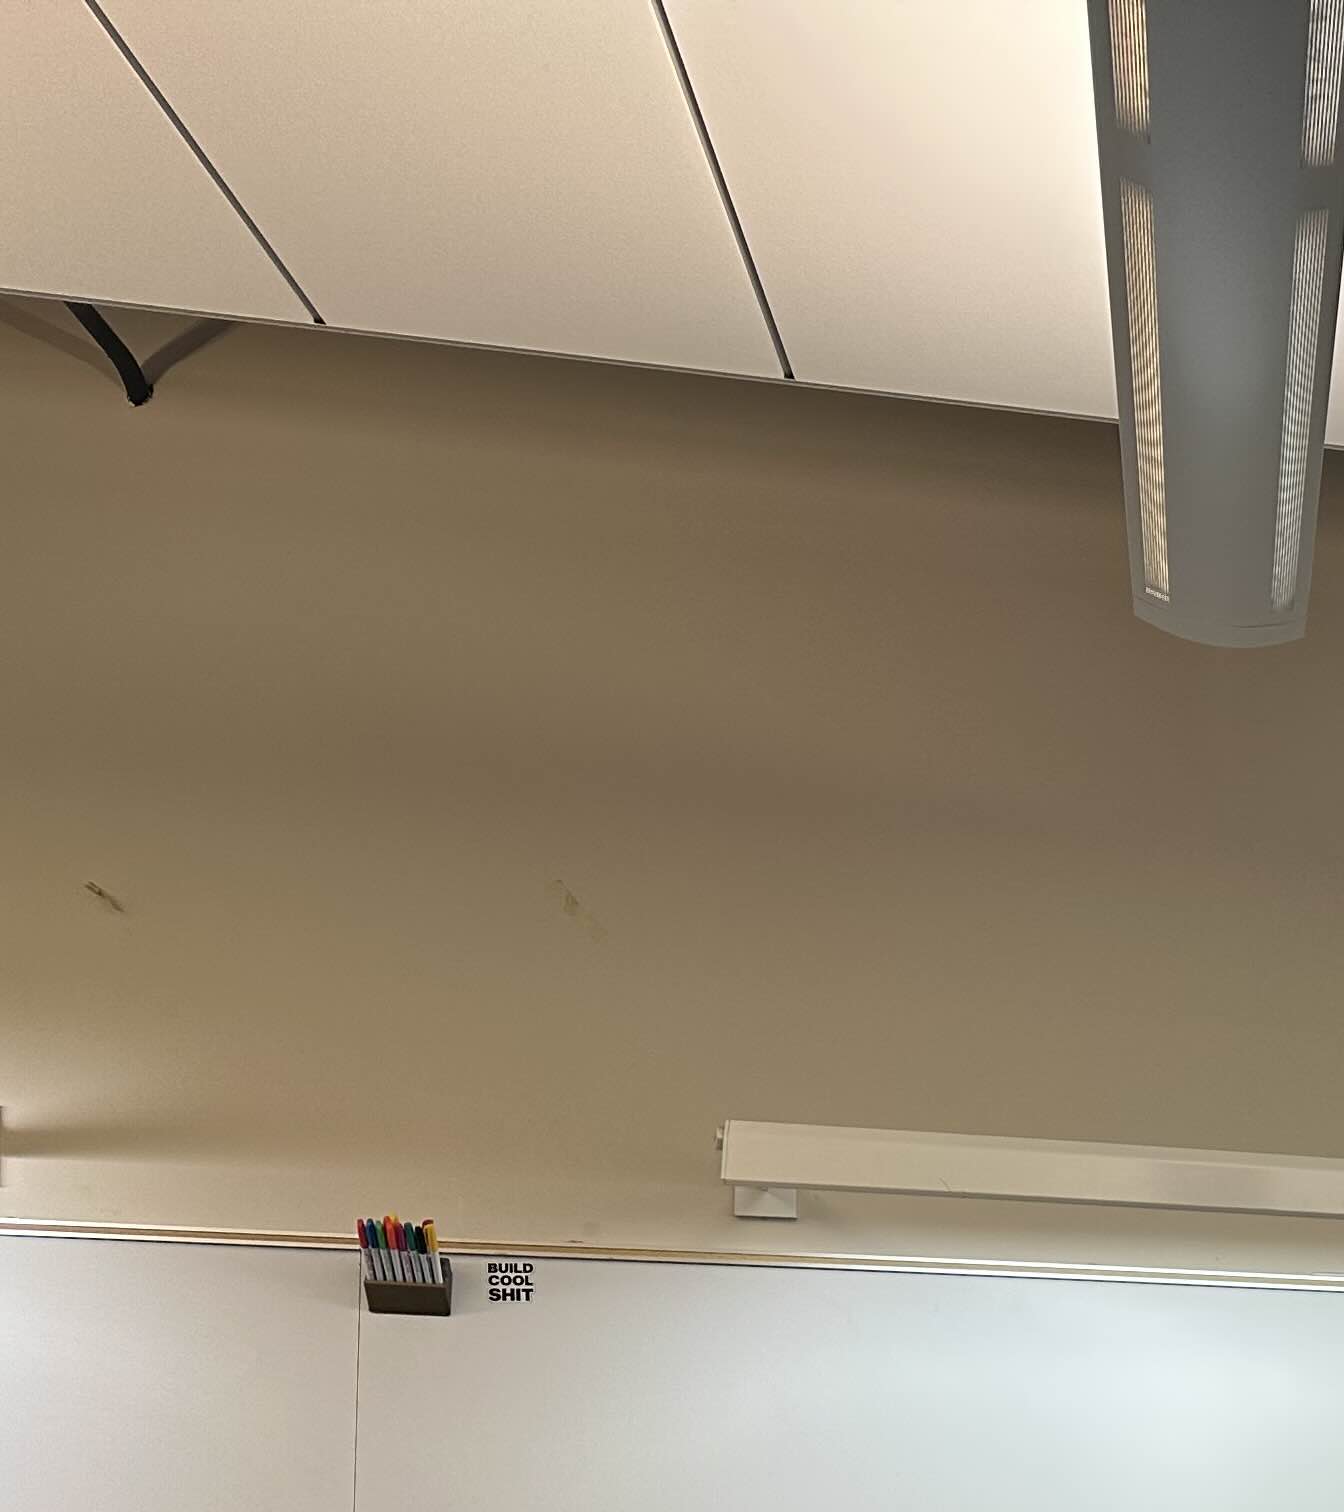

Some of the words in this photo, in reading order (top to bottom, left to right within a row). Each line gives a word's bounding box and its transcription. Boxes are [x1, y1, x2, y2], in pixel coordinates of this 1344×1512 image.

[488, 1263, 534, 1274] BUILD
[488, 1275, 534, 1286] COOL
[488, 1289, 534, 1302] SHIT
